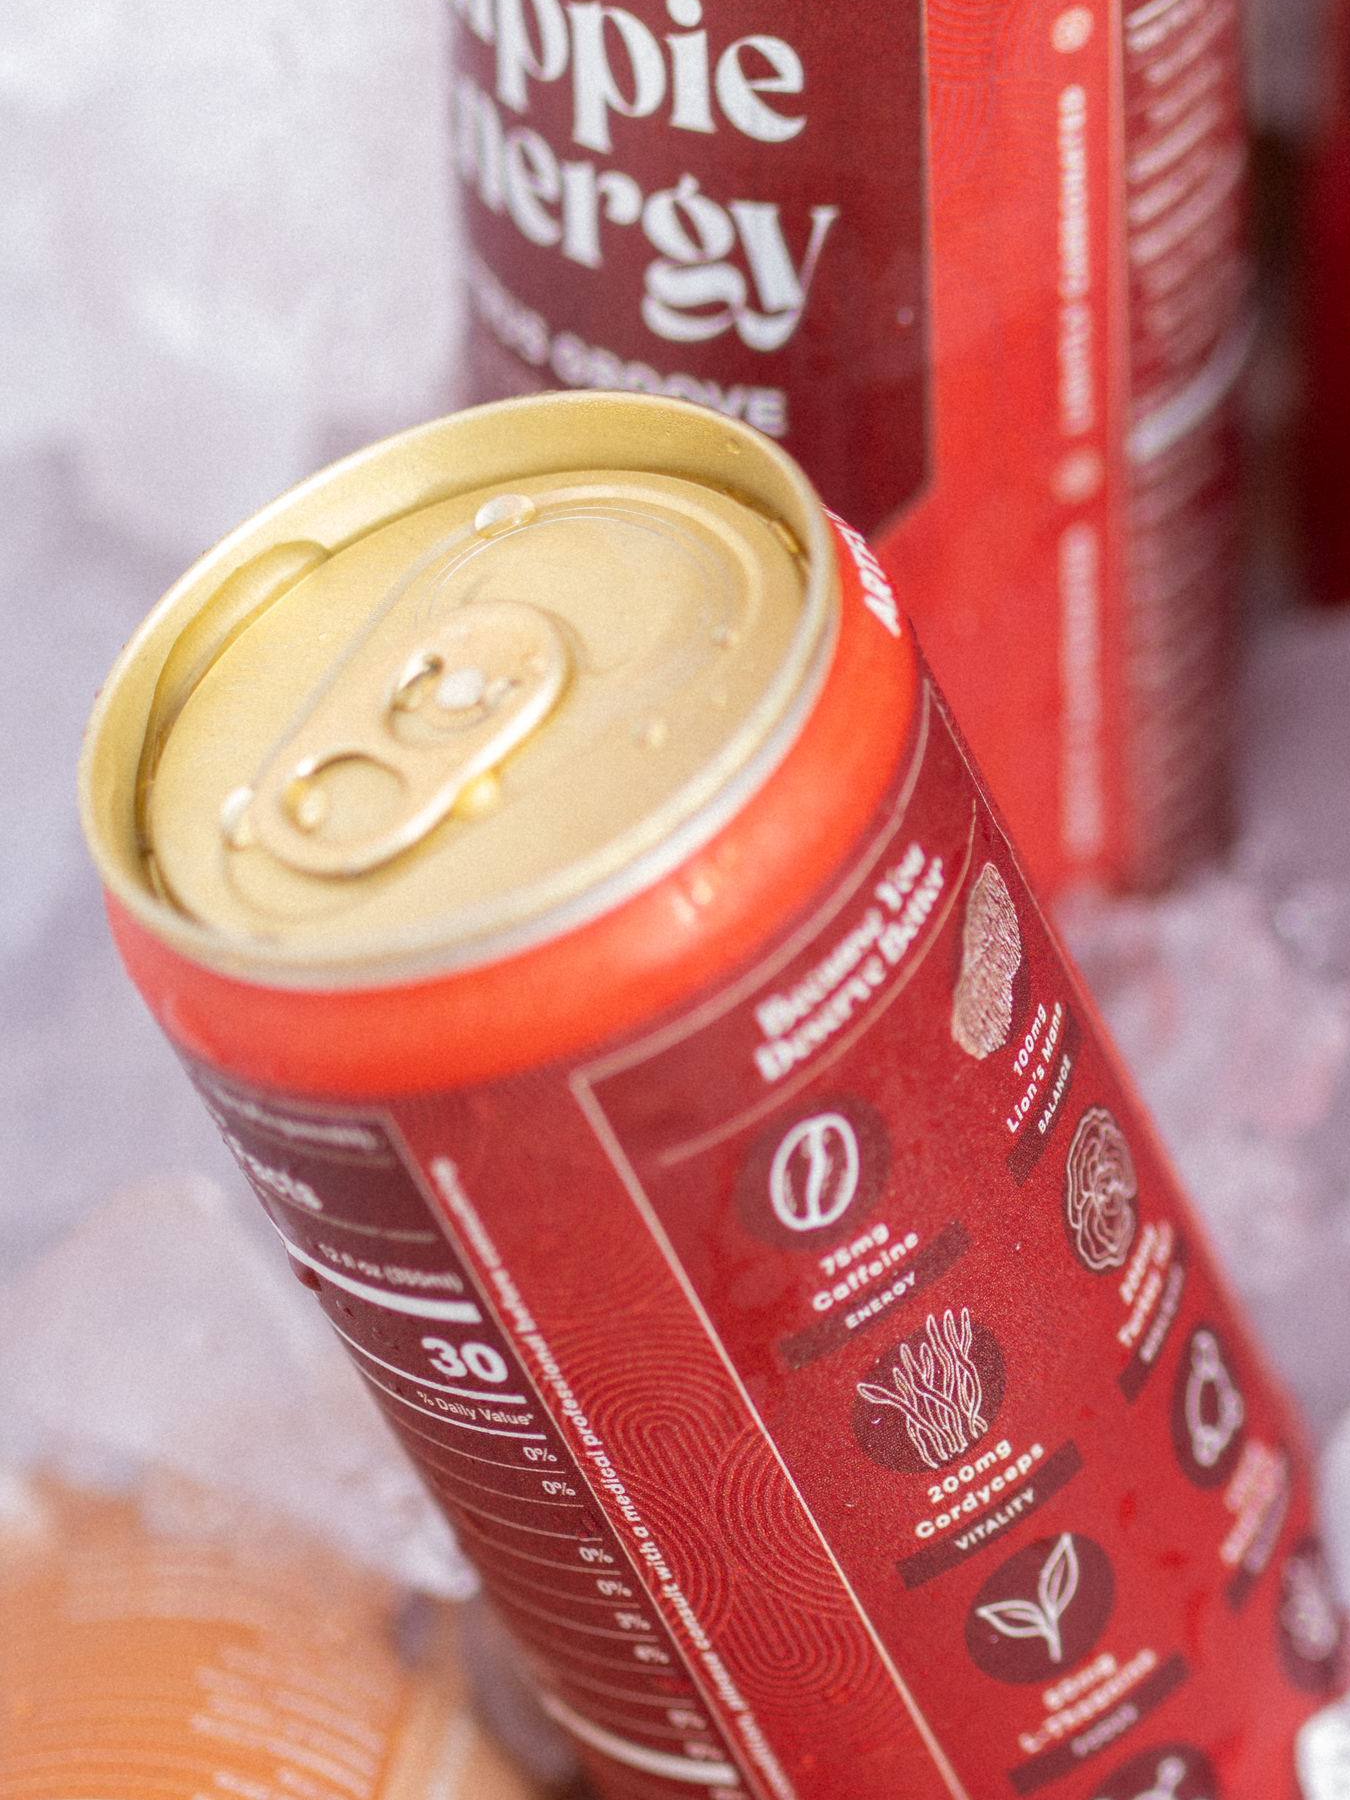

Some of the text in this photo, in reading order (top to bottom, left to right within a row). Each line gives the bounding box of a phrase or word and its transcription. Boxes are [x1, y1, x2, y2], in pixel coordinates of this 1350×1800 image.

[452, 70, 840, 352] nergy
[1006, 1001, 1064, 1134] Lion's Mane
[1013, 1001, 1048, 1077] 100mg
[1037, 1055, 1072, 1136] BALANCE
[812, 1230, 920, 1312] Caffeine
[818, 1222, 891, 1276] 75mg
[844, 1270, 918, 1330] ENERGY
[420, 1335, 509, 1384] 30
[521, 1331, 605, 1448] professional
[416, 1390, 435, 1407] %
[434, 1396, 477, 1421] Daily
[522, 1445, 558, 1463] 0%
[589, 1445, 645, 1526] medical
[927, 1438, 1014, 1504] 200mg
[541, 1479, 577, 1497] 0%
[914, 1442, 1046, 1539] Cordyceps
[953, 1487, 1036, 1550] VITALITY
[578, 1544, 615, 1566] 0%
[632, 1523, 649, 1539] a
[639, 1539, 673, 1584] with
[660, 1578, 711, 1652] consult
